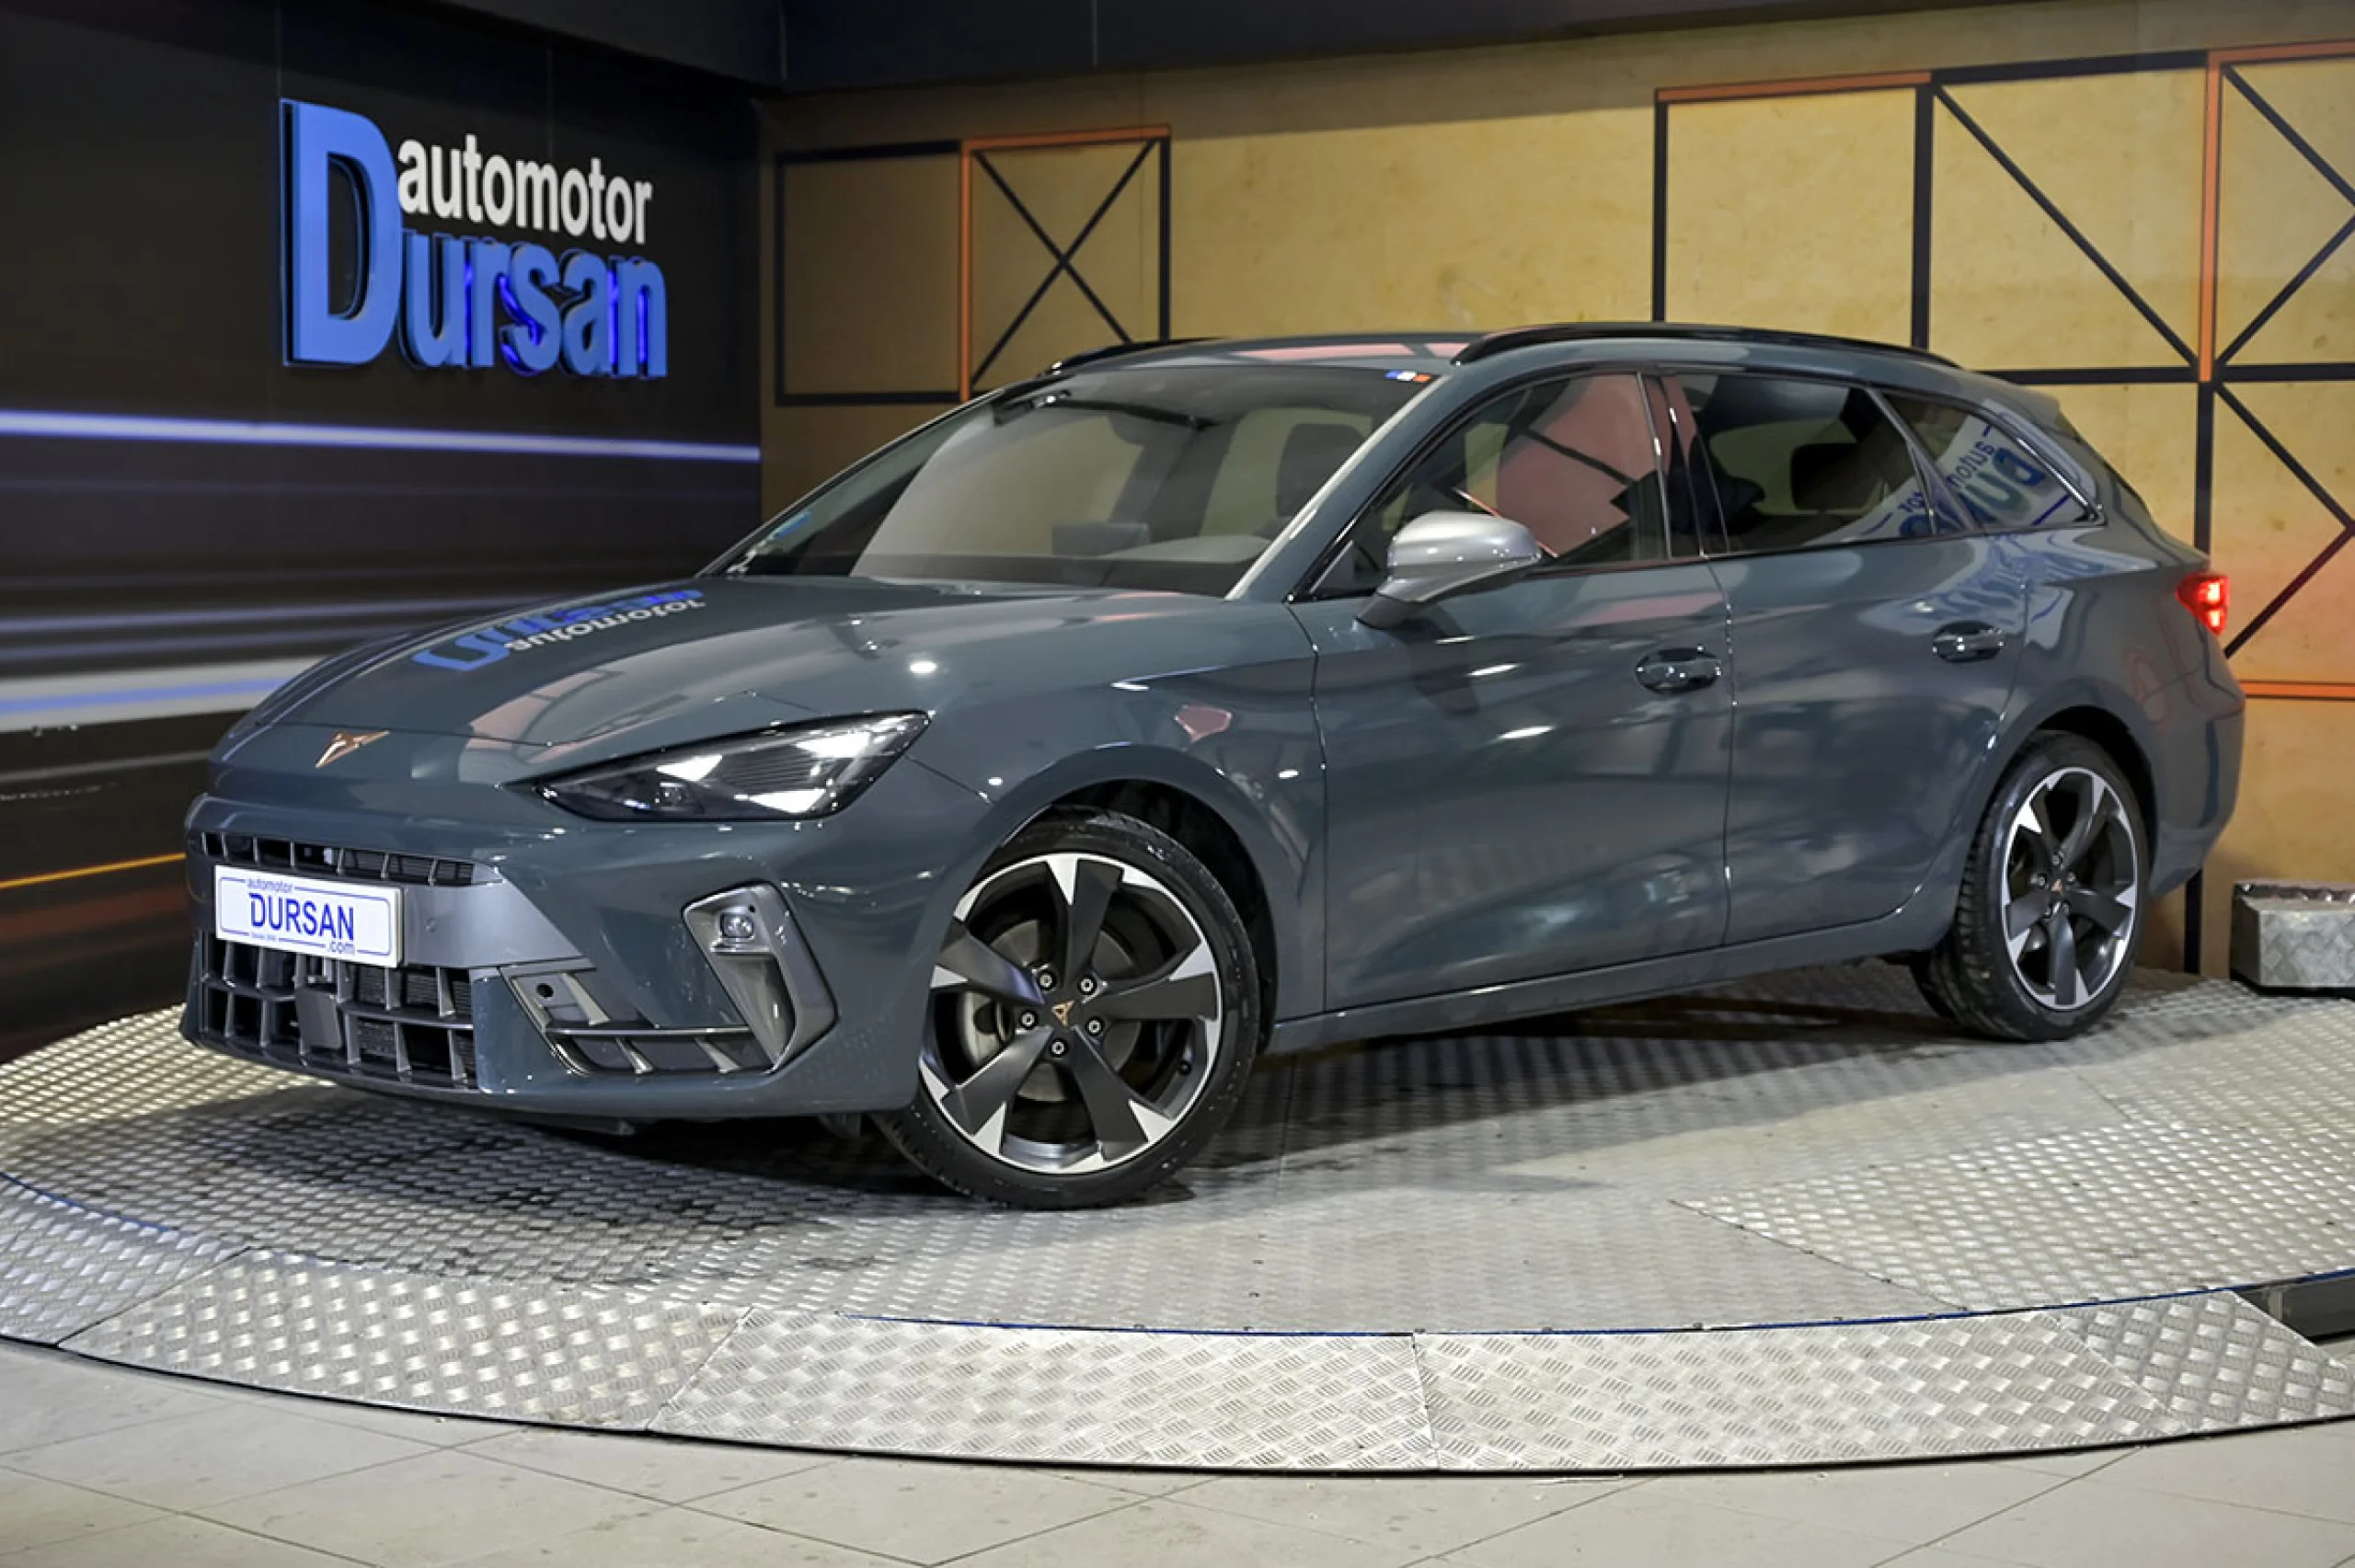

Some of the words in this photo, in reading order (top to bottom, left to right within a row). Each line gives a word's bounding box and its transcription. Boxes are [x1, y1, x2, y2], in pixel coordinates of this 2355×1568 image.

[280, 97, 669, 380] Dursan
[398, 133, 652, 245] automotor
[248, 892, 354, 941] DURSAN
